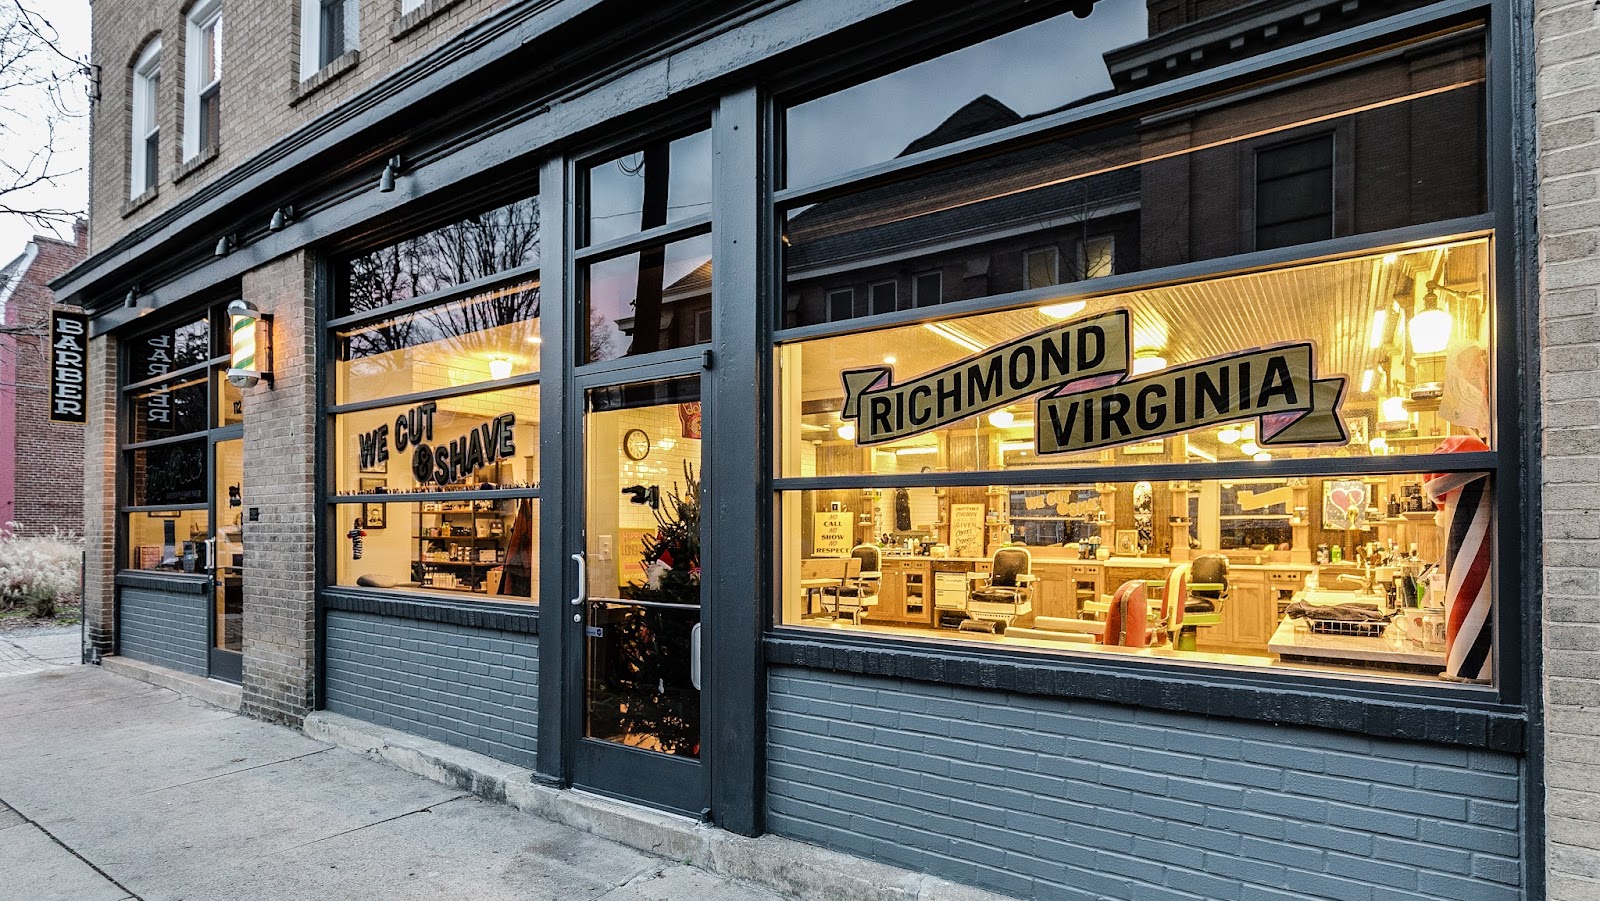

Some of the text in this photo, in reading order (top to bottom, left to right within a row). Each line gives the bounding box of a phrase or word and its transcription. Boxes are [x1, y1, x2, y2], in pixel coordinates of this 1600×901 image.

[54, 318, 84, 416] BARBER
[870, 325, 1106, 436] RICHMOND
[1047, 355, 1299, 447] VIRGINIA
[359, 401, 437, 469] WE CUT
